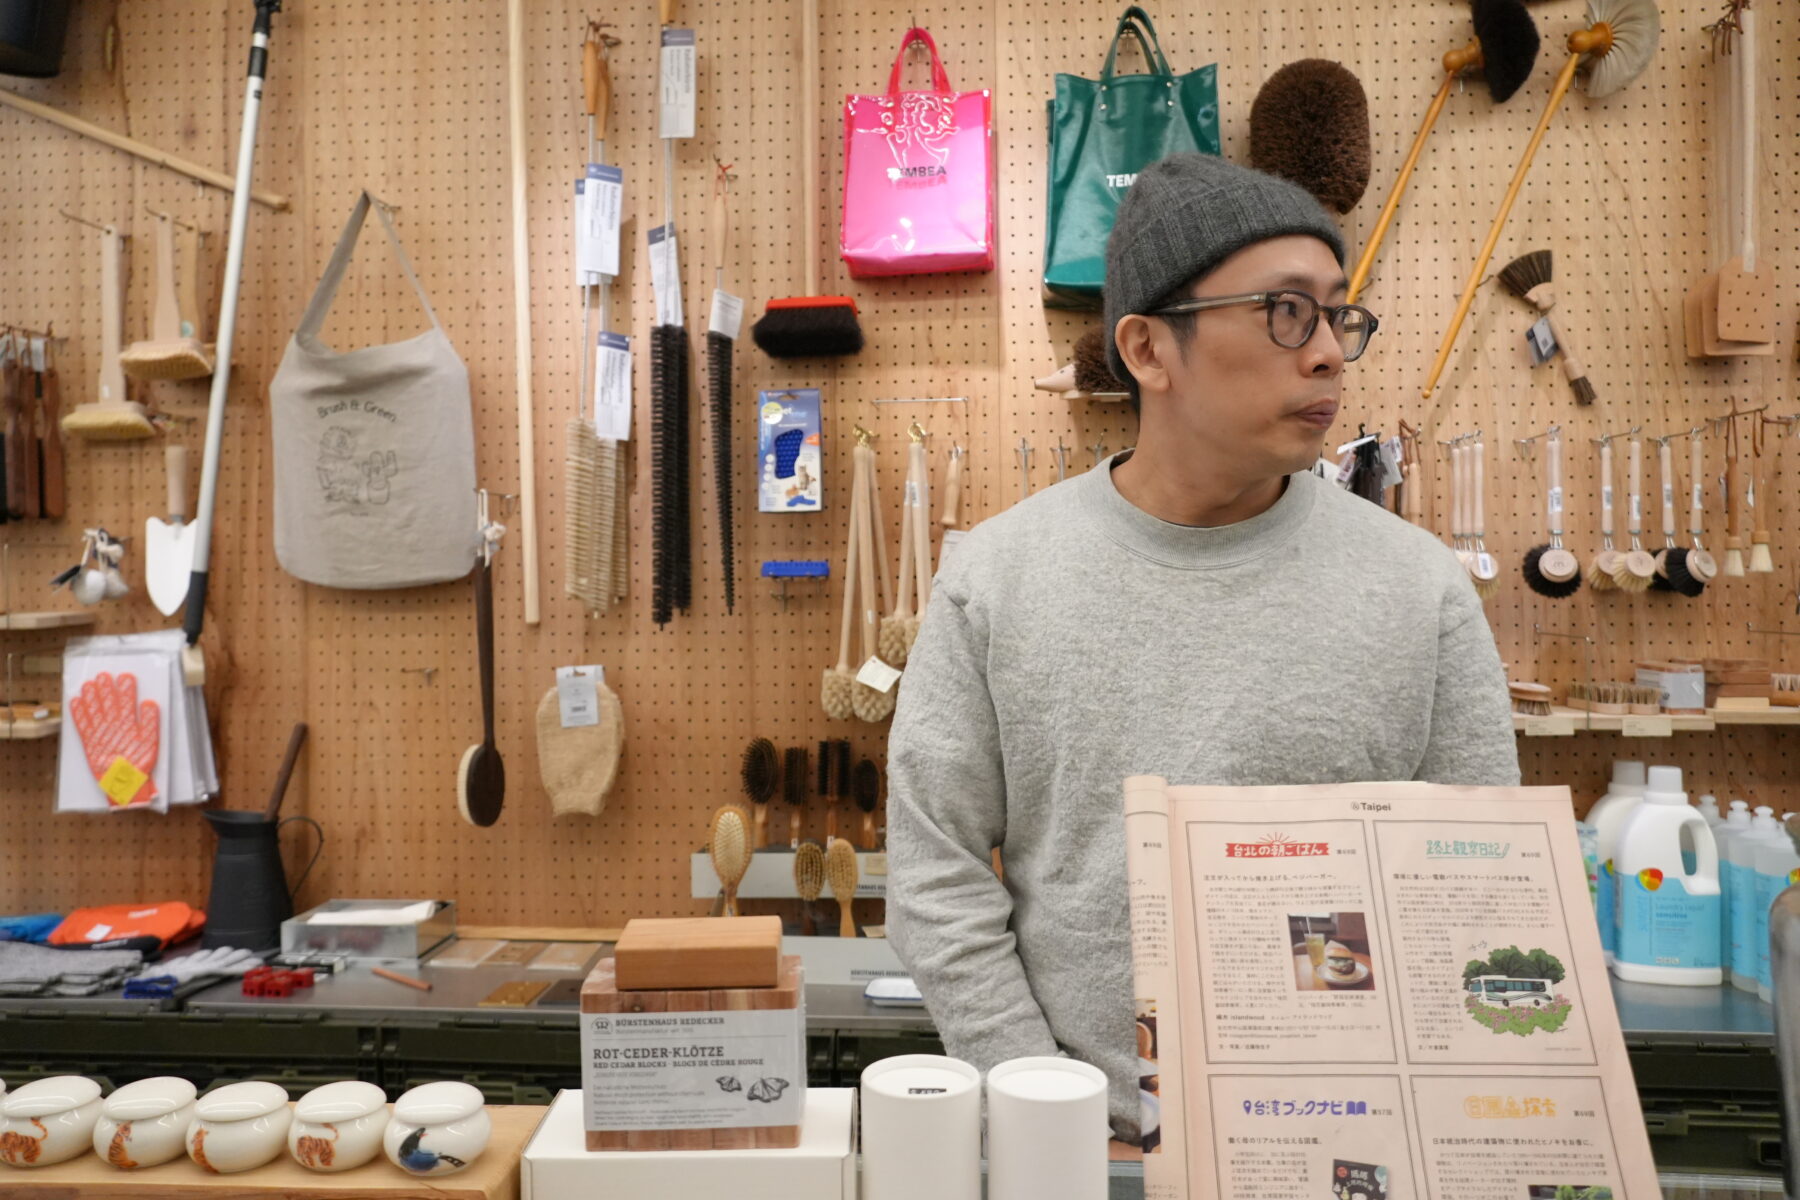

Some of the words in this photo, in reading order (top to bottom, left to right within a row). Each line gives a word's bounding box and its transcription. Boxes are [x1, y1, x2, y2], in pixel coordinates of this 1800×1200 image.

[1106, 173, 1138, 187] TEM
[364, 401, 397, 422] Green
[1360, 802, 1391, 812] Taipei
[1233, 843, 1322, 857] 台北の朝ごはん
[615, 1017, 678, 1026] BÜRSTENHAUS
[680, 1017, 725, 1025] REDECKER
[593, 1045, 724, 1059] ROT-CEDER-KLÖTZE
[1254, 1099, 1343, 1116] 台湾ブックナビ
